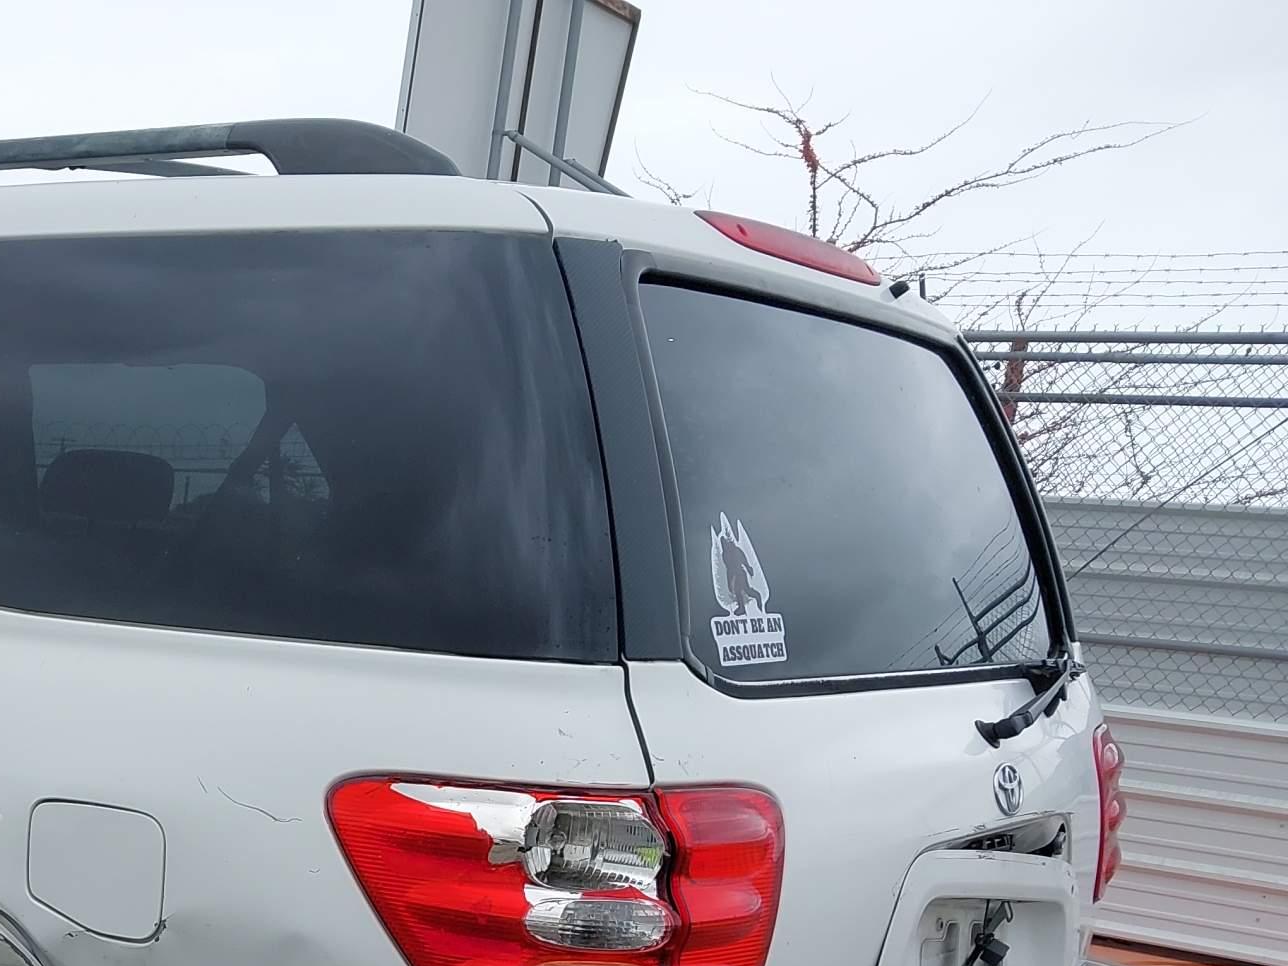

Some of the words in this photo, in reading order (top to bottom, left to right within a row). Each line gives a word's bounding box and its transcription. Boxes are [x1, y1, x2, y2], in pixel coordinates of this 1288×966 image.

[750, 618, 765, 633] BE
[766, 617, 782, 632] AN
[722, 642, 785, 662] ASSQUATCH
